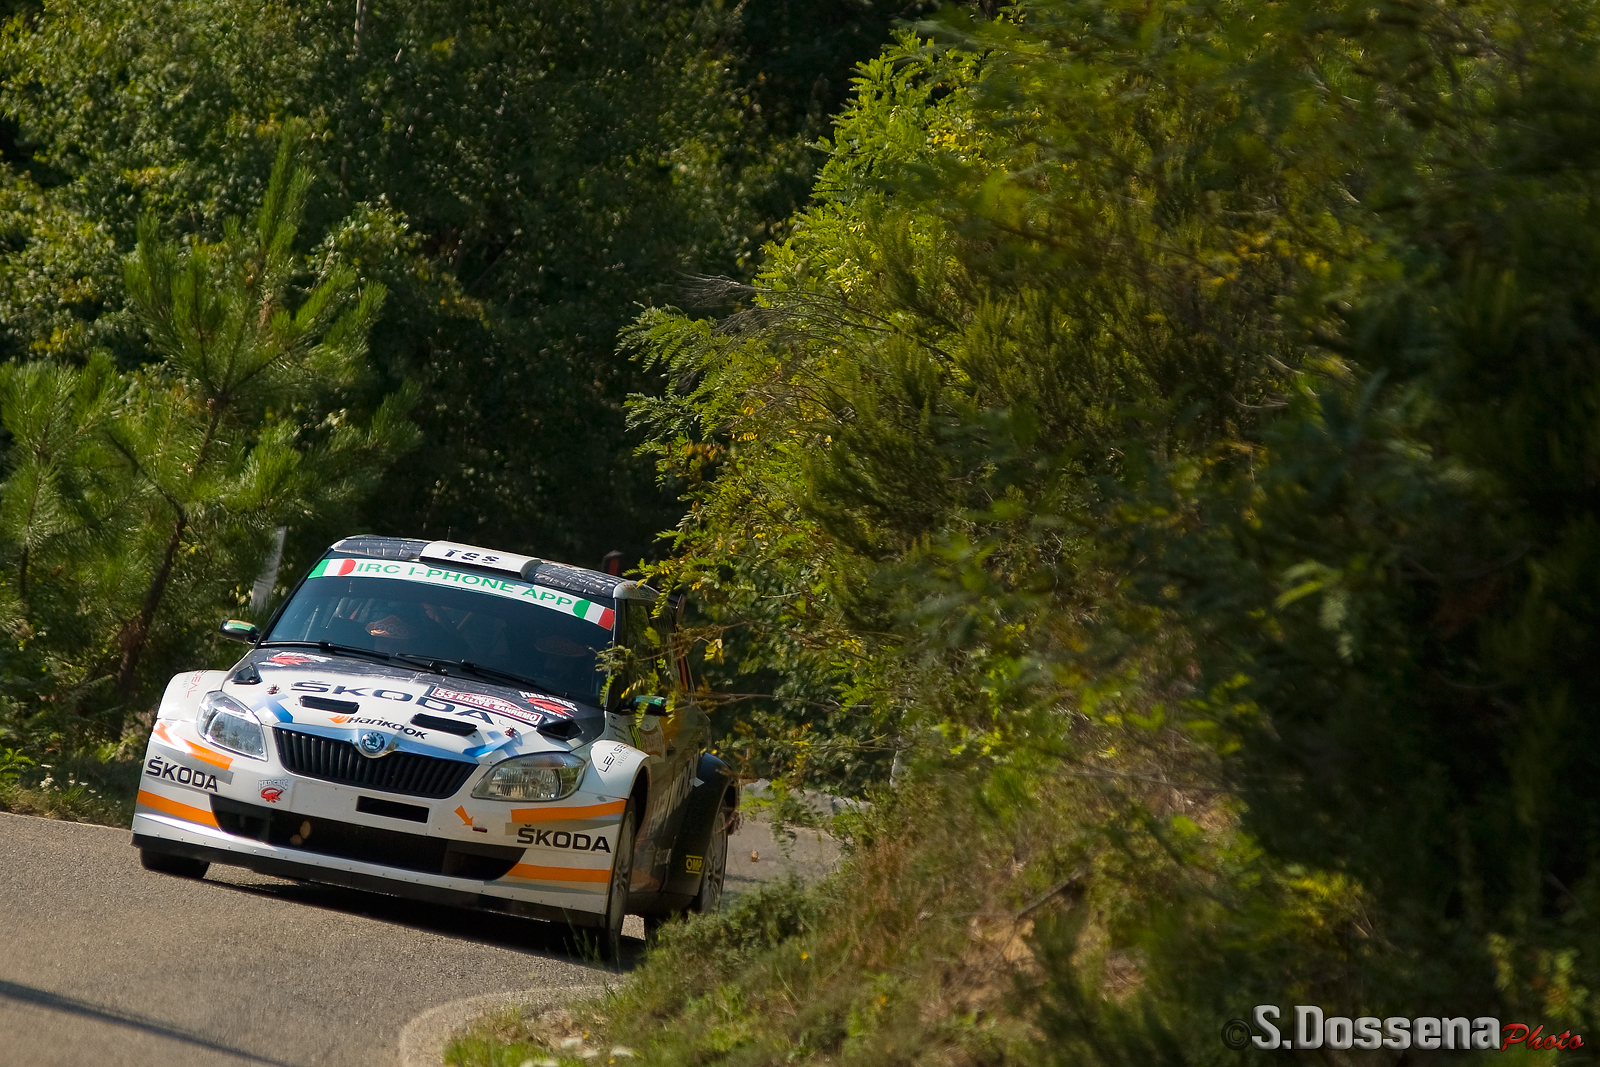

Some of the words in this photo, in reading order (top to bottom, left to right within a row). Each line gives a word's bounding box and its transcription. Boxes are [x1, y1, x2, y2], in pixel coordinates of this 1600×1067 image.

[356, 563, 400, 574] IRC
[408, 567, 516, 593] I-PHONE
[521, 588, 572, 607] APP
[290, 681, 494, 725] ŠKODA
[456, 693, 491, 709] RALLYE
[493, 704, 538, 721] SANREMO
[145, 756, 218, 792] ŠKODA
[516, 824, 611, 854] ŠKODA
[685, 858, 703, 871] OMP
